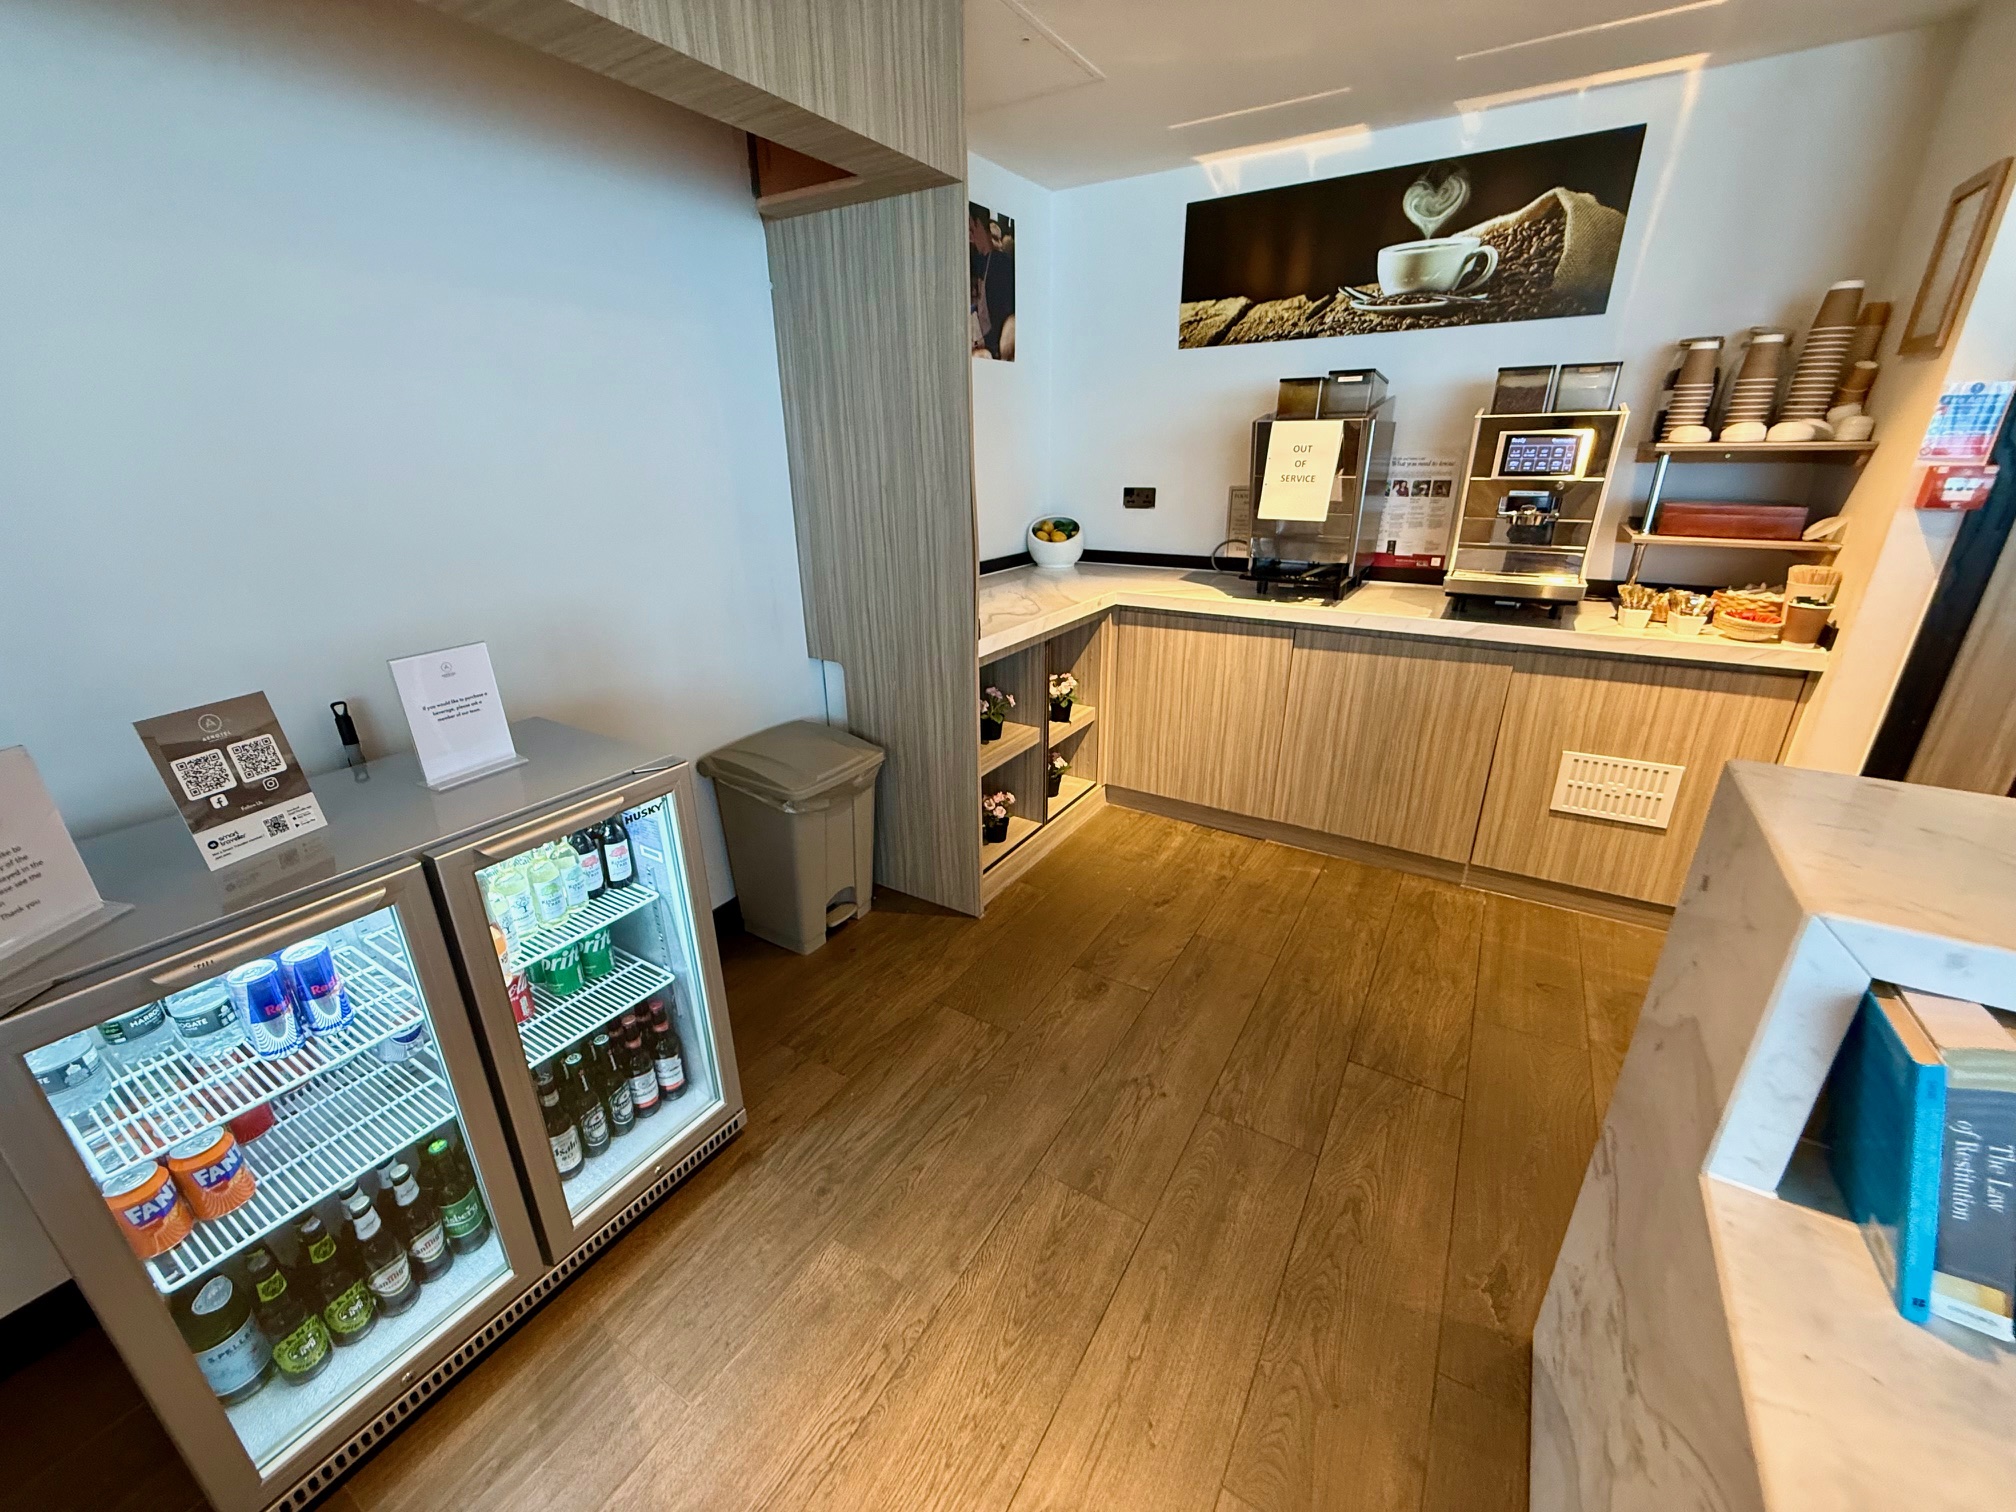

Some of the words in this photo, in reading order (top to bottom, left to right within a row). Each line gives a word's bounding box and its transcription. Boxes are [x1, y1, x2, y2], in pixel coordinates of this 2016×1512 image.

[1293, 445, 1313, 453] OUT
[1294, 459, 1307, 468] OF
[1280, 474, 1316, 483] SERVICE
[465, 693, 484, 702] purchase
[240, 802, 255, 811] Follow
[625, 801, 663, 825] HUSKY
[218, 830, 239, 840] smart
[14, 855, 28, 863] the
[30, 860, 44, 868] the
[28, 872, 42, 881] the
[0, 905, 24, 920] Thank
[26, 899, 41, 910] you
[580, 929, 612, 954] prit
[542, 945, 580, 971] prit
[1949, 1120, 1983, 1141] of
[192, 1146, 242, 1187] FANT
[1988, 1144, 2016, 1176] The
[1951, 1141, 1981, 1221] Restitution
[124, 1177, 176, 1225] FANT
[1986, 1178, 2014, 1213] Law
